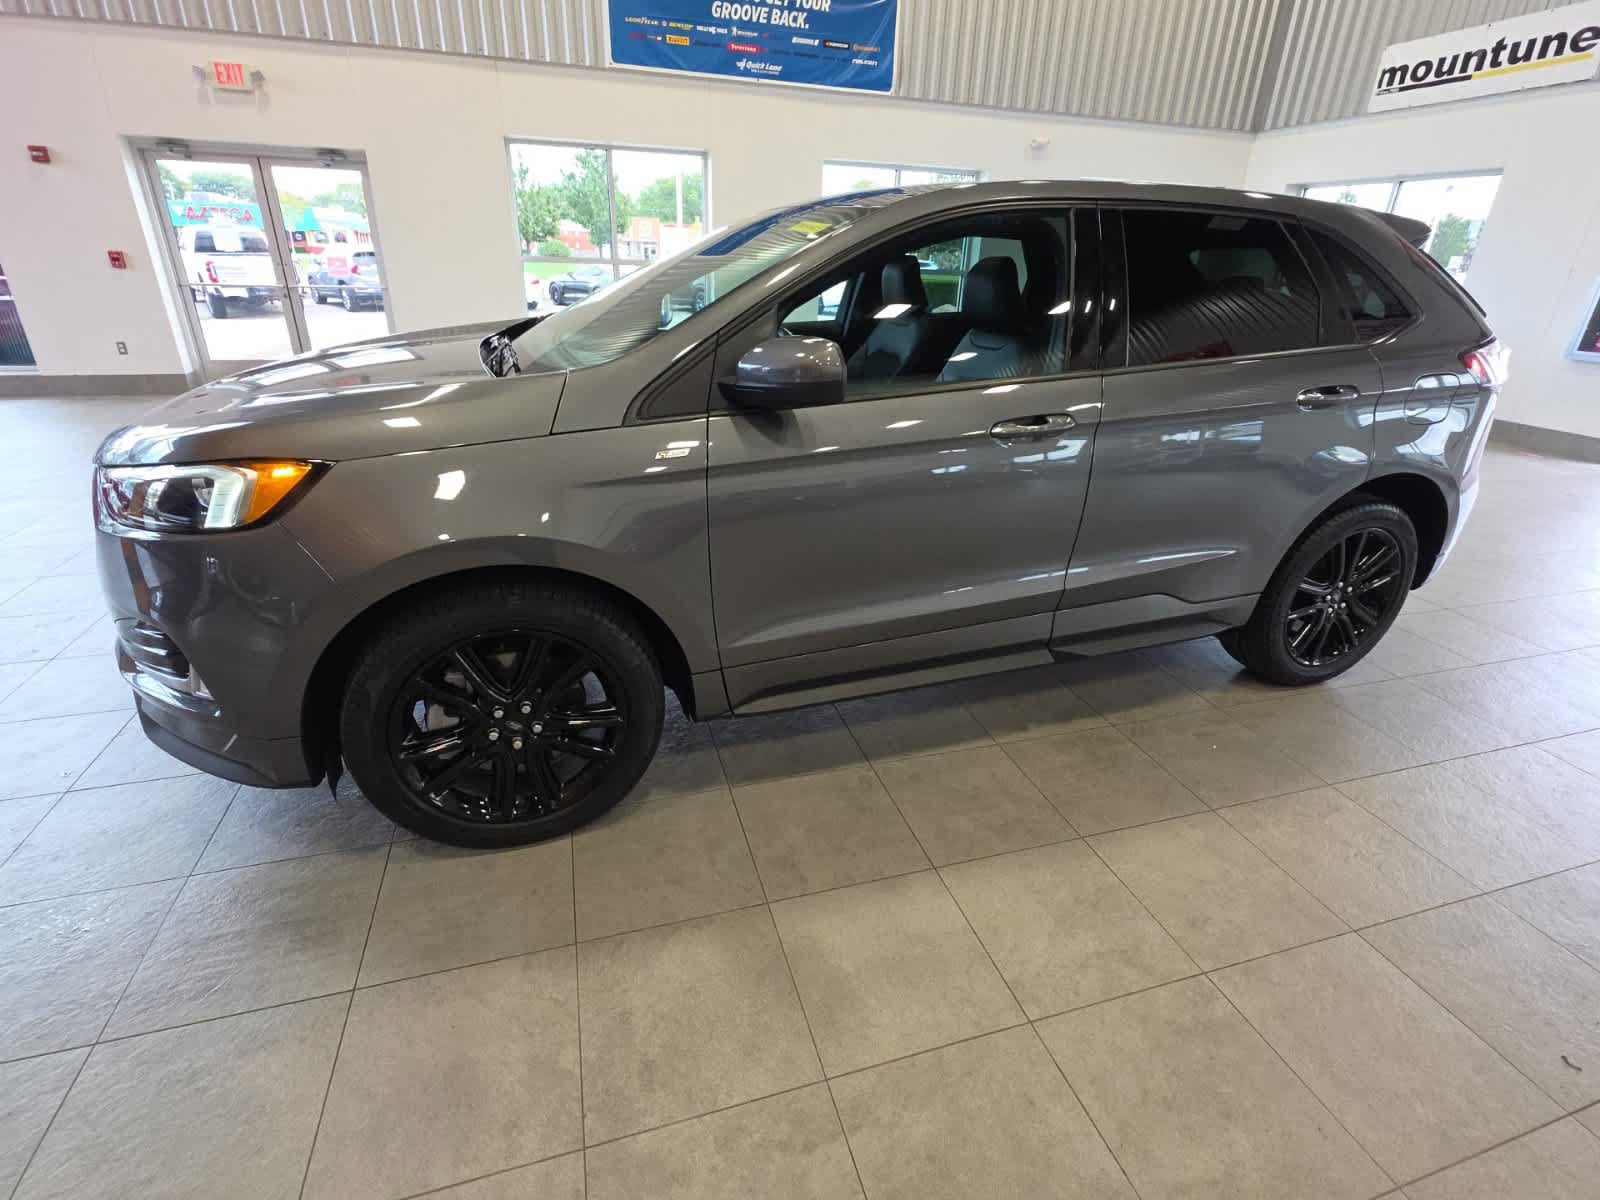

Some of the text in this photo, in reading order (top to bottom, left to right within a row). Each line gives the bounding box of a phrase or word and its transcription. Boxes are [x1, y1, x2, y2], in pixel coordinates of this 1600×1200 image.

[712, 1, 809, 29] GROOVE BACK.
[1376, 25, 1600, 89] mountune
[213, 62, 245, 86] EXIT
